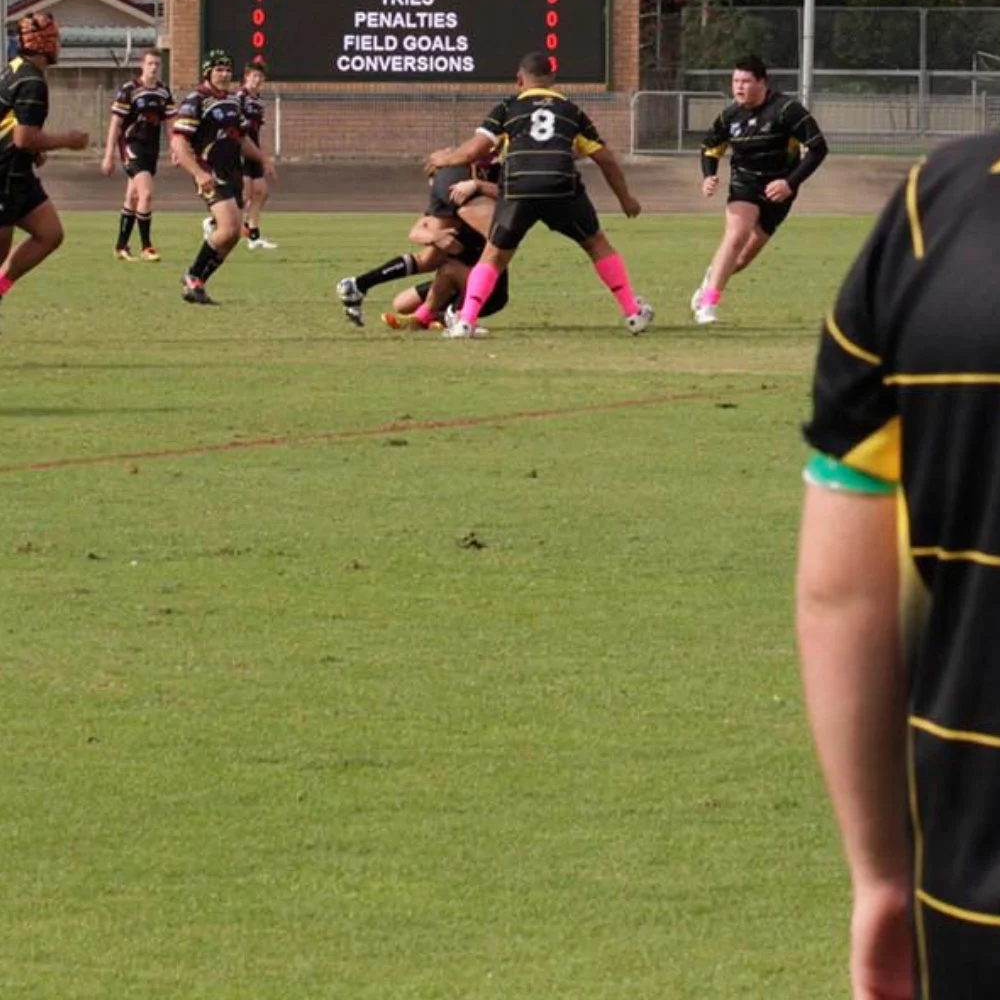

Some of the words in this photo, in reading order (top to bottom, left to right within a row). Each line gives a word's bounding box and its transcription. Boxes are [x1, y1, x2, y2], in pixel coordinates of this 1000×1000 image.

[252, 8, 266, 26] 0
[354, 11, 458, 29] PENALTIES
[546, 9, 558, 28] 0
[252, 30, 266, 49] 0
[343, 34, 399, 52] FIELD
[402, 34, 469, 52] GOALS
[546, 32, 558, 51] 0
[336, 54, 475, 73] CONVERSIONS
[530, 107, 556, 142] 8
